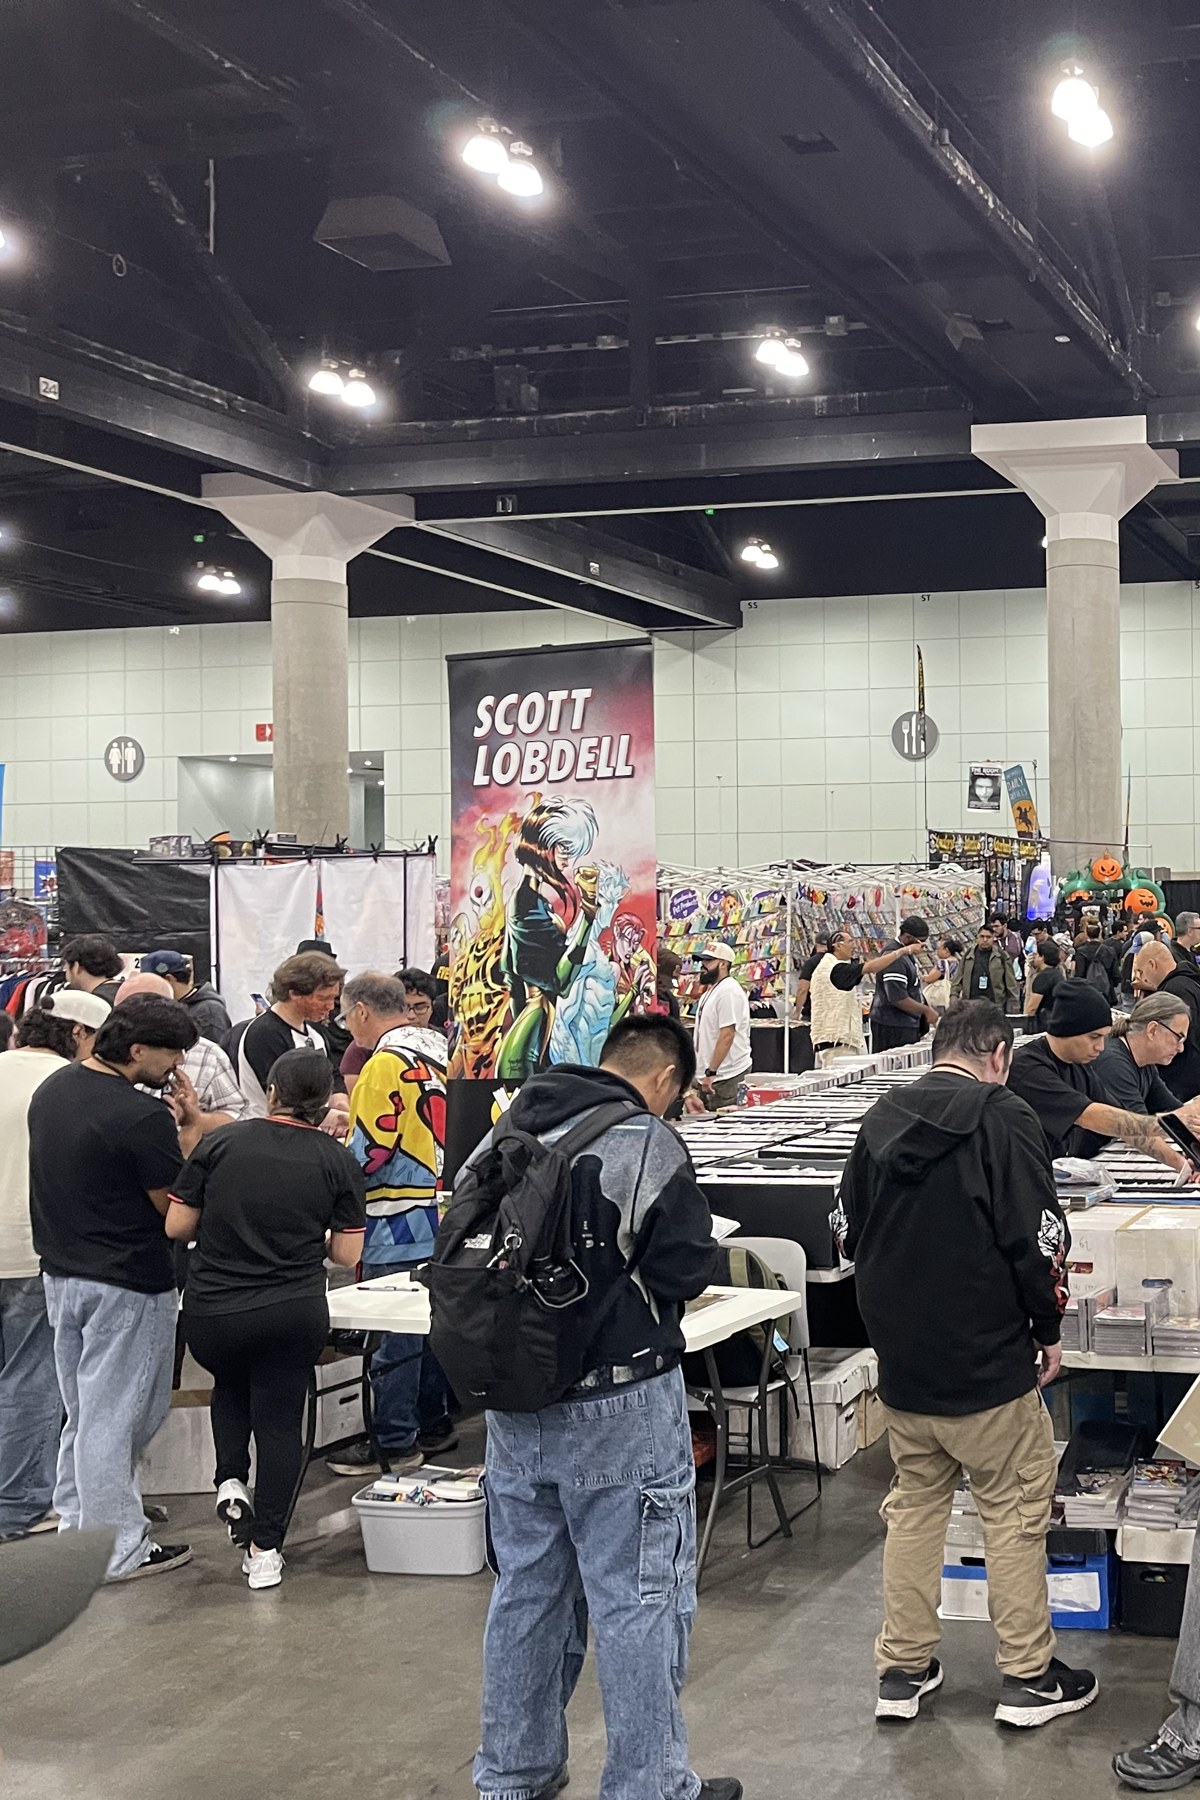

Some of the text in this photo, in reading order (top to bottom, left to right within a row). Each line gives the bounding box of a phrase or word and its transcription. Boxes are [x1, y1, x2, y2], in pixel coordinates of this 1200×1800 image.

[42, 381, 58, 395] 24
[921, 594, 931, 602] ST
[473, 688, 592, 739] SCOTT
[473, 734, 634, 786] LOBDELL
